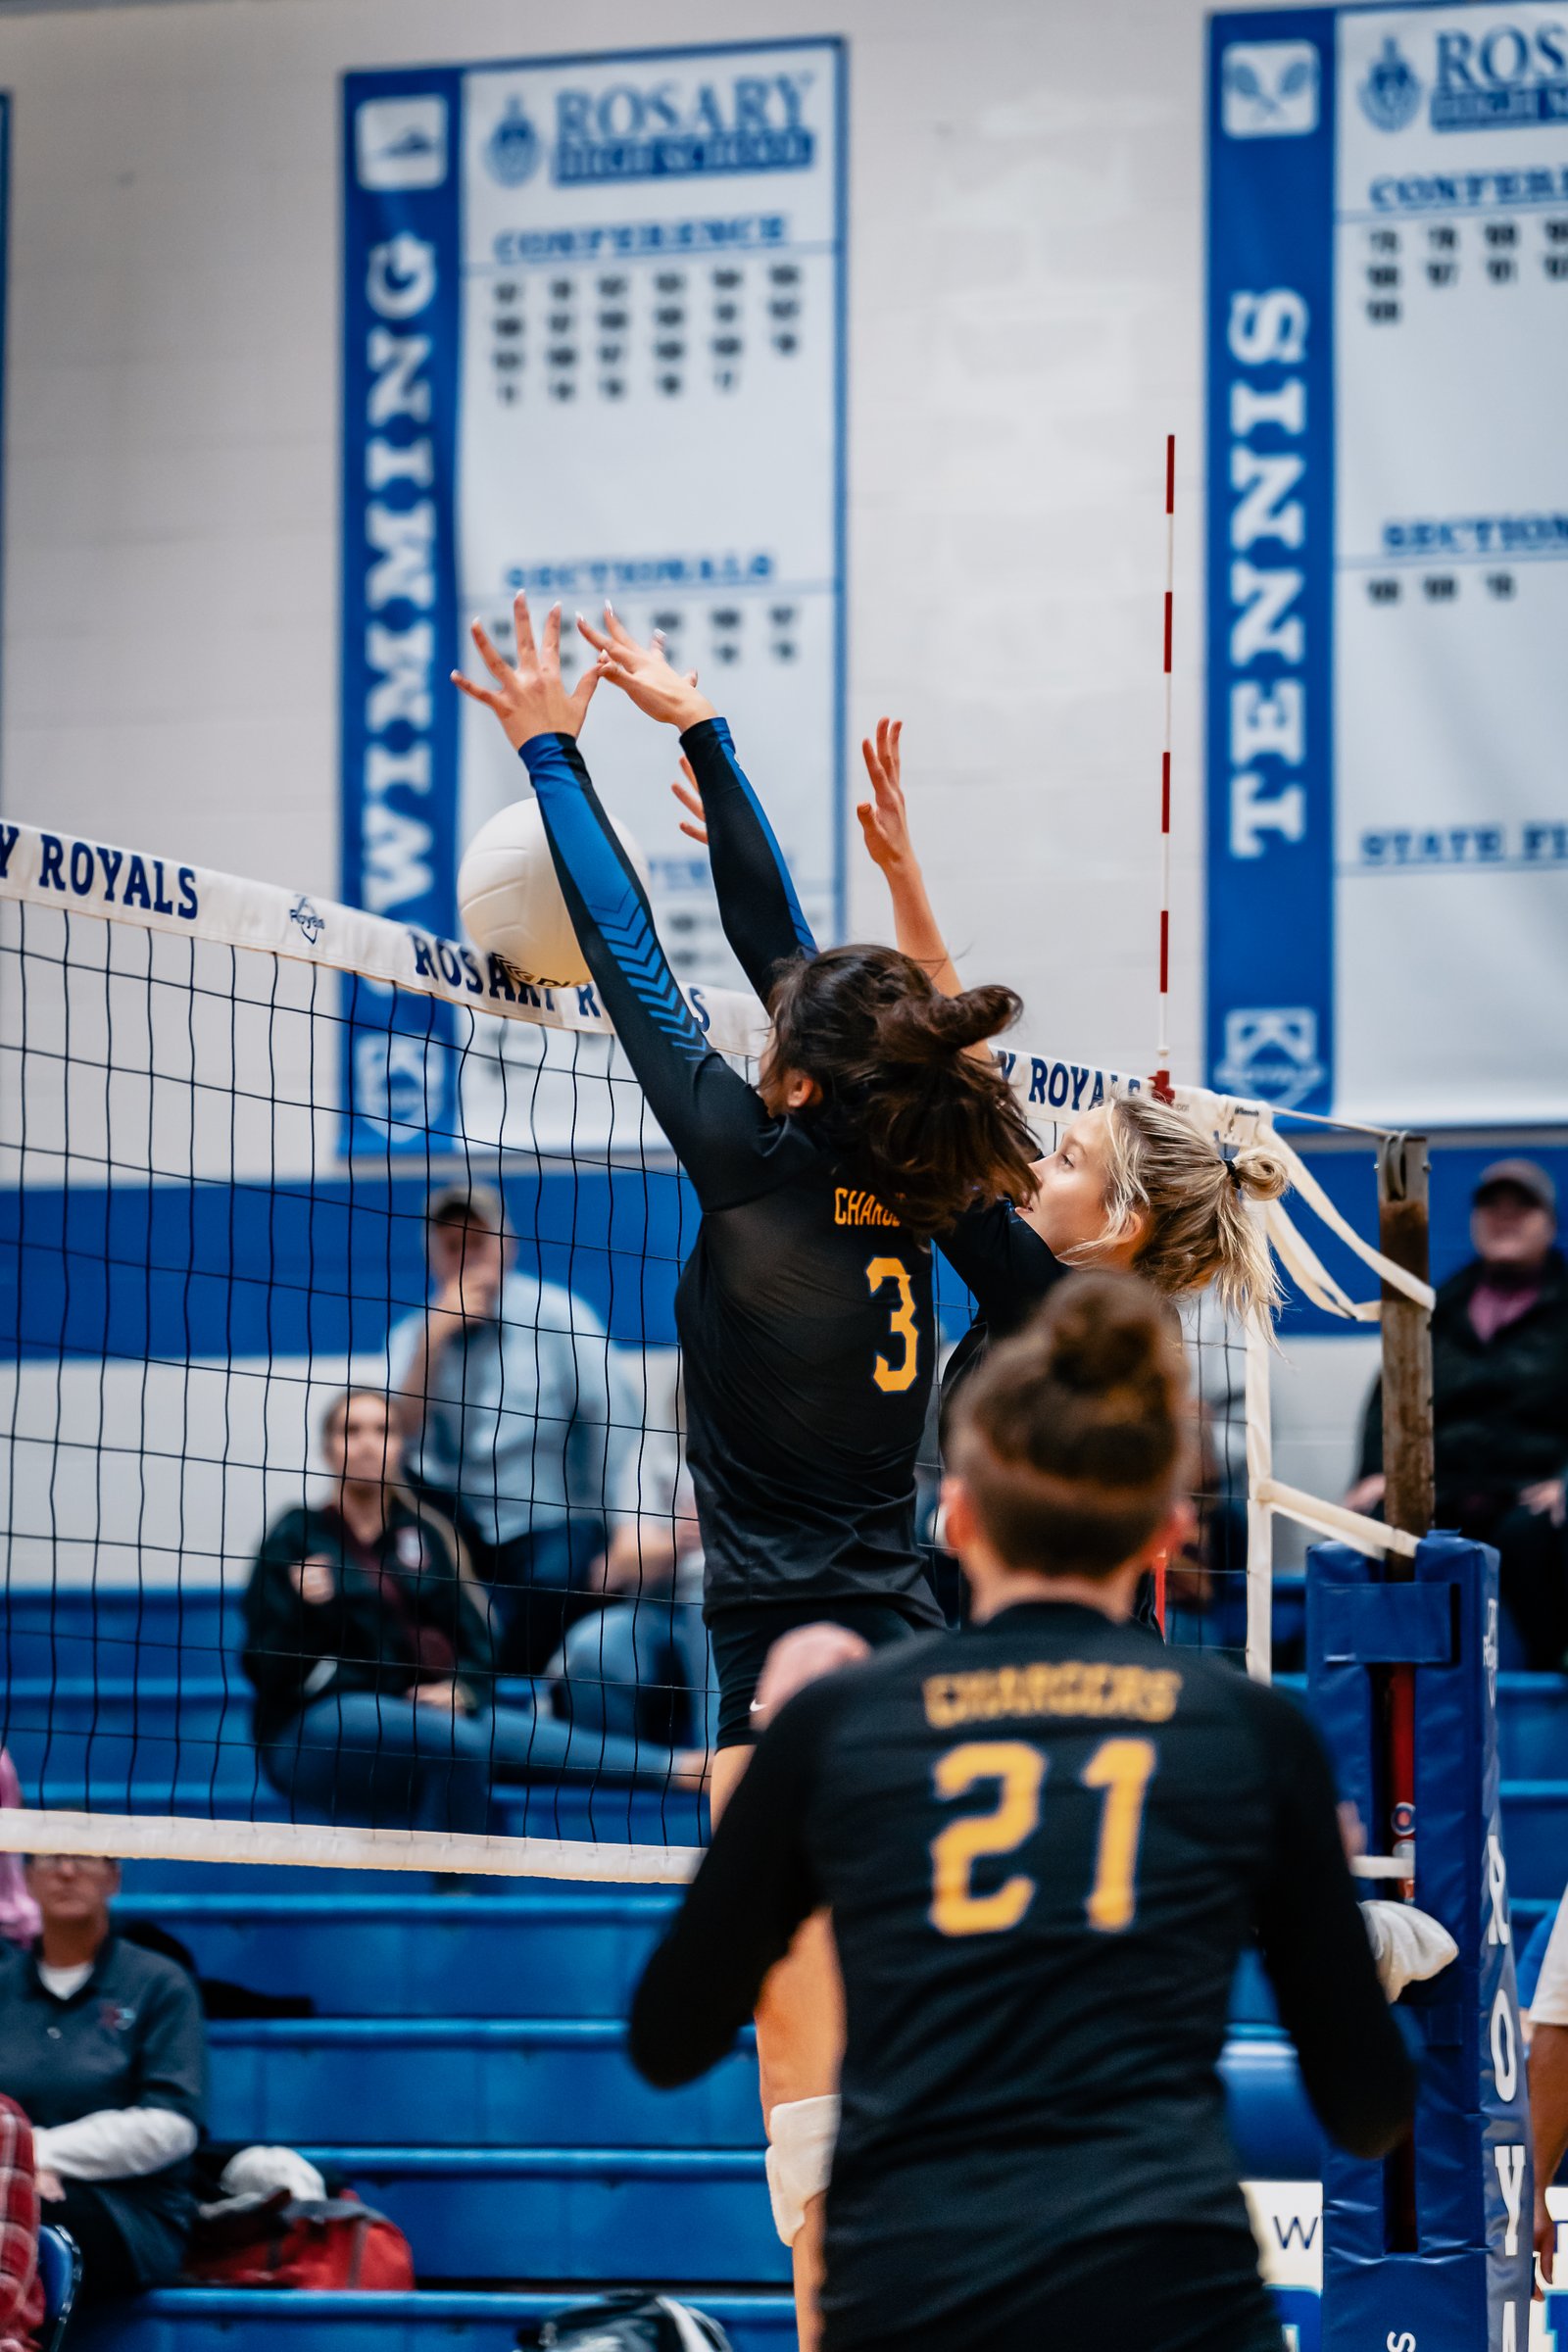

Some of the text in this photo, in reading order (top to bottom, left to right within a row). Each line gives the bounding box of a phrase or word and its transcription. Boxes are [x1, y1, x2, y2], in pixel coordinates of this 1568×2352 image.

[556, 72, 808, 144] ROSARY
[362, 229, 437, 998] WIMMING
[1228, 289, 1309, 859] TENNIS
[39, 834, 198, 920] ROYALS
[1362, 826, 1505, 865] STATE
[834, 1187, 901, 1227] CHAR
[865, 1254, 919, 1395] 3
[929, 1737, 1158, 1936] 21
